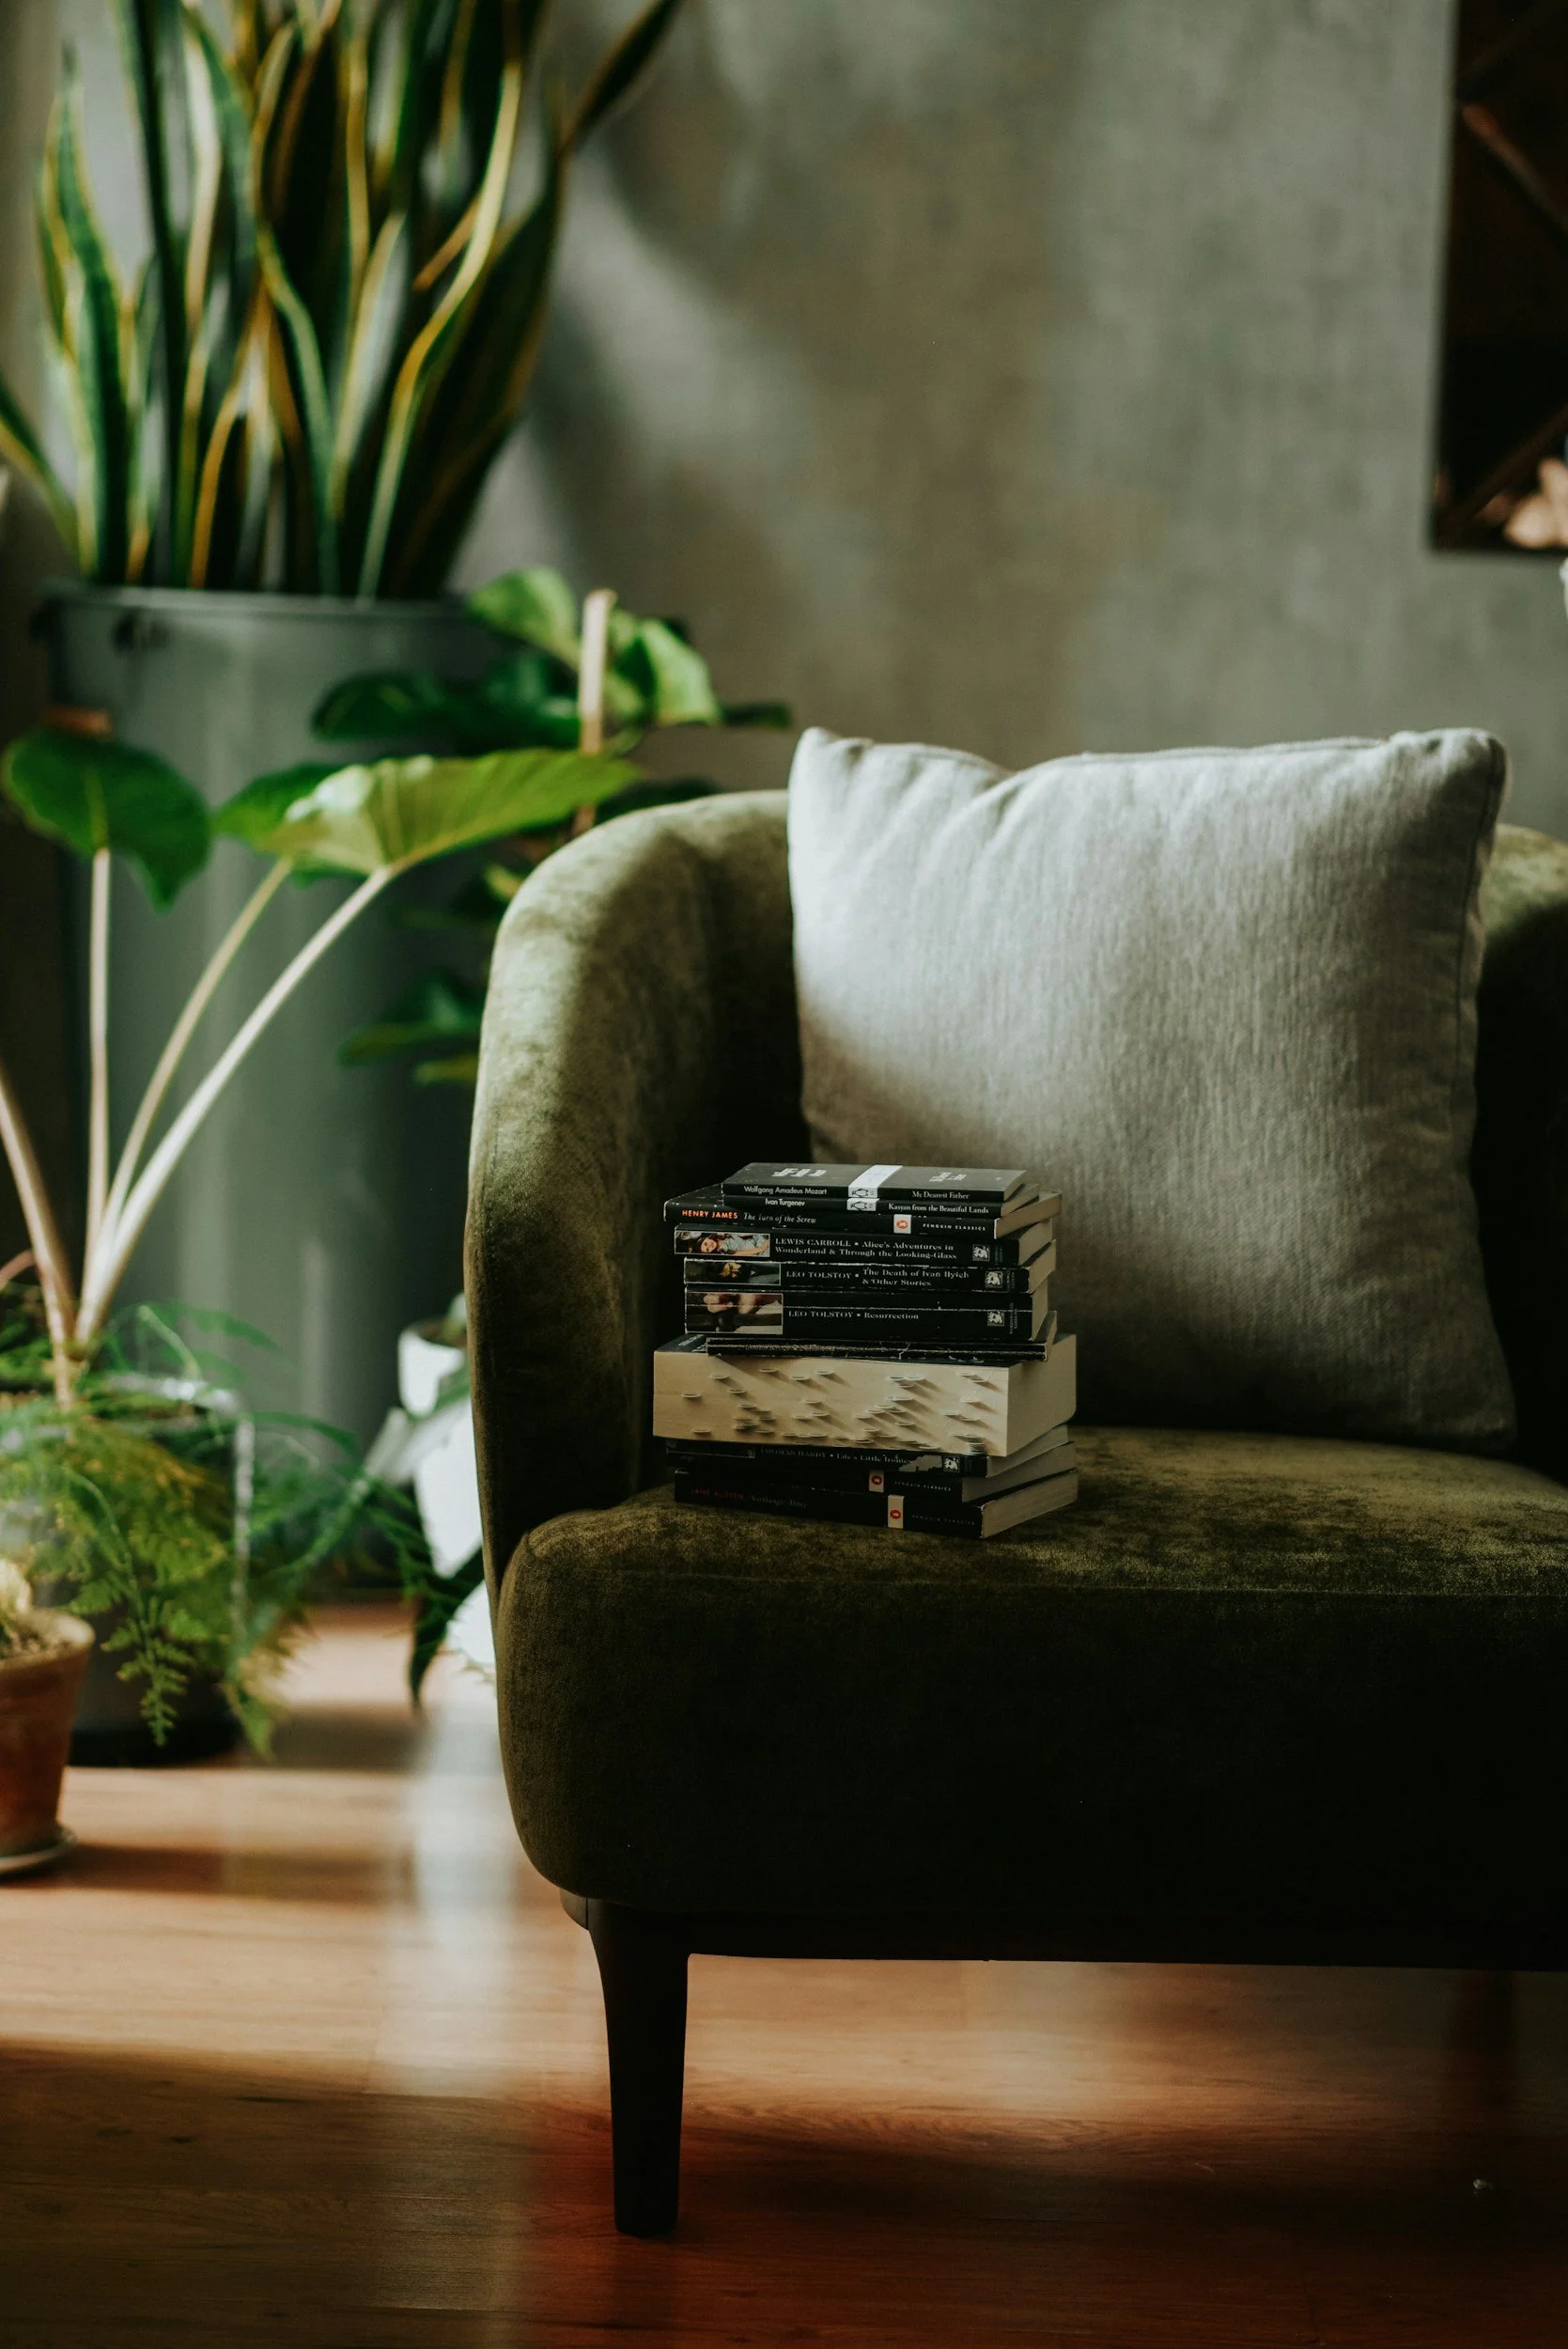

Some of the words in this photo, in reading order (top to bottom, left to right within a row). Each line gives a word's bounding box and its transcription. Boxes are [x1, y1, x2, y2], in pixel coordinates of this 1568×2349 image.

[743, 1185, 774, 1194] Wolfgang
[911, 1190, 923, 1199] My
[924, 1190, 948, 1199] Dearest
[949, 1191, 970, 1200] Father
[779, 1198, 805, 1207] Turgenev
[889, 1203, 911, 1212] Kasyan
[939, 1205, 968, 1213] Beautiful
[743, 1212, 755, 1221] The
[775, 1214, 783, 1224] of
[796, 1215, 817, 1223] Screw
[775, 1237, 804, 1246] LEWIS
[807, 1238, 851, 1248] CARROLL
[862, 1240, 891, 1249] Alice's
[893, 1242, 942, 1251] Adventures
[775, 1246, 826, 1255] Wonderland
[839, 1248, 876, 1258] Through
[895, 1251, 957, 1260] Looking-Glass
[808, 1271, 851, 1280] TOLSTOY
[862, 1268, 879, 1276] The
[882, 1268, 908, 1277] Death
[873, 1278, 898, 1286] Other
[864, 1312, 920, 1320] Resurrection
